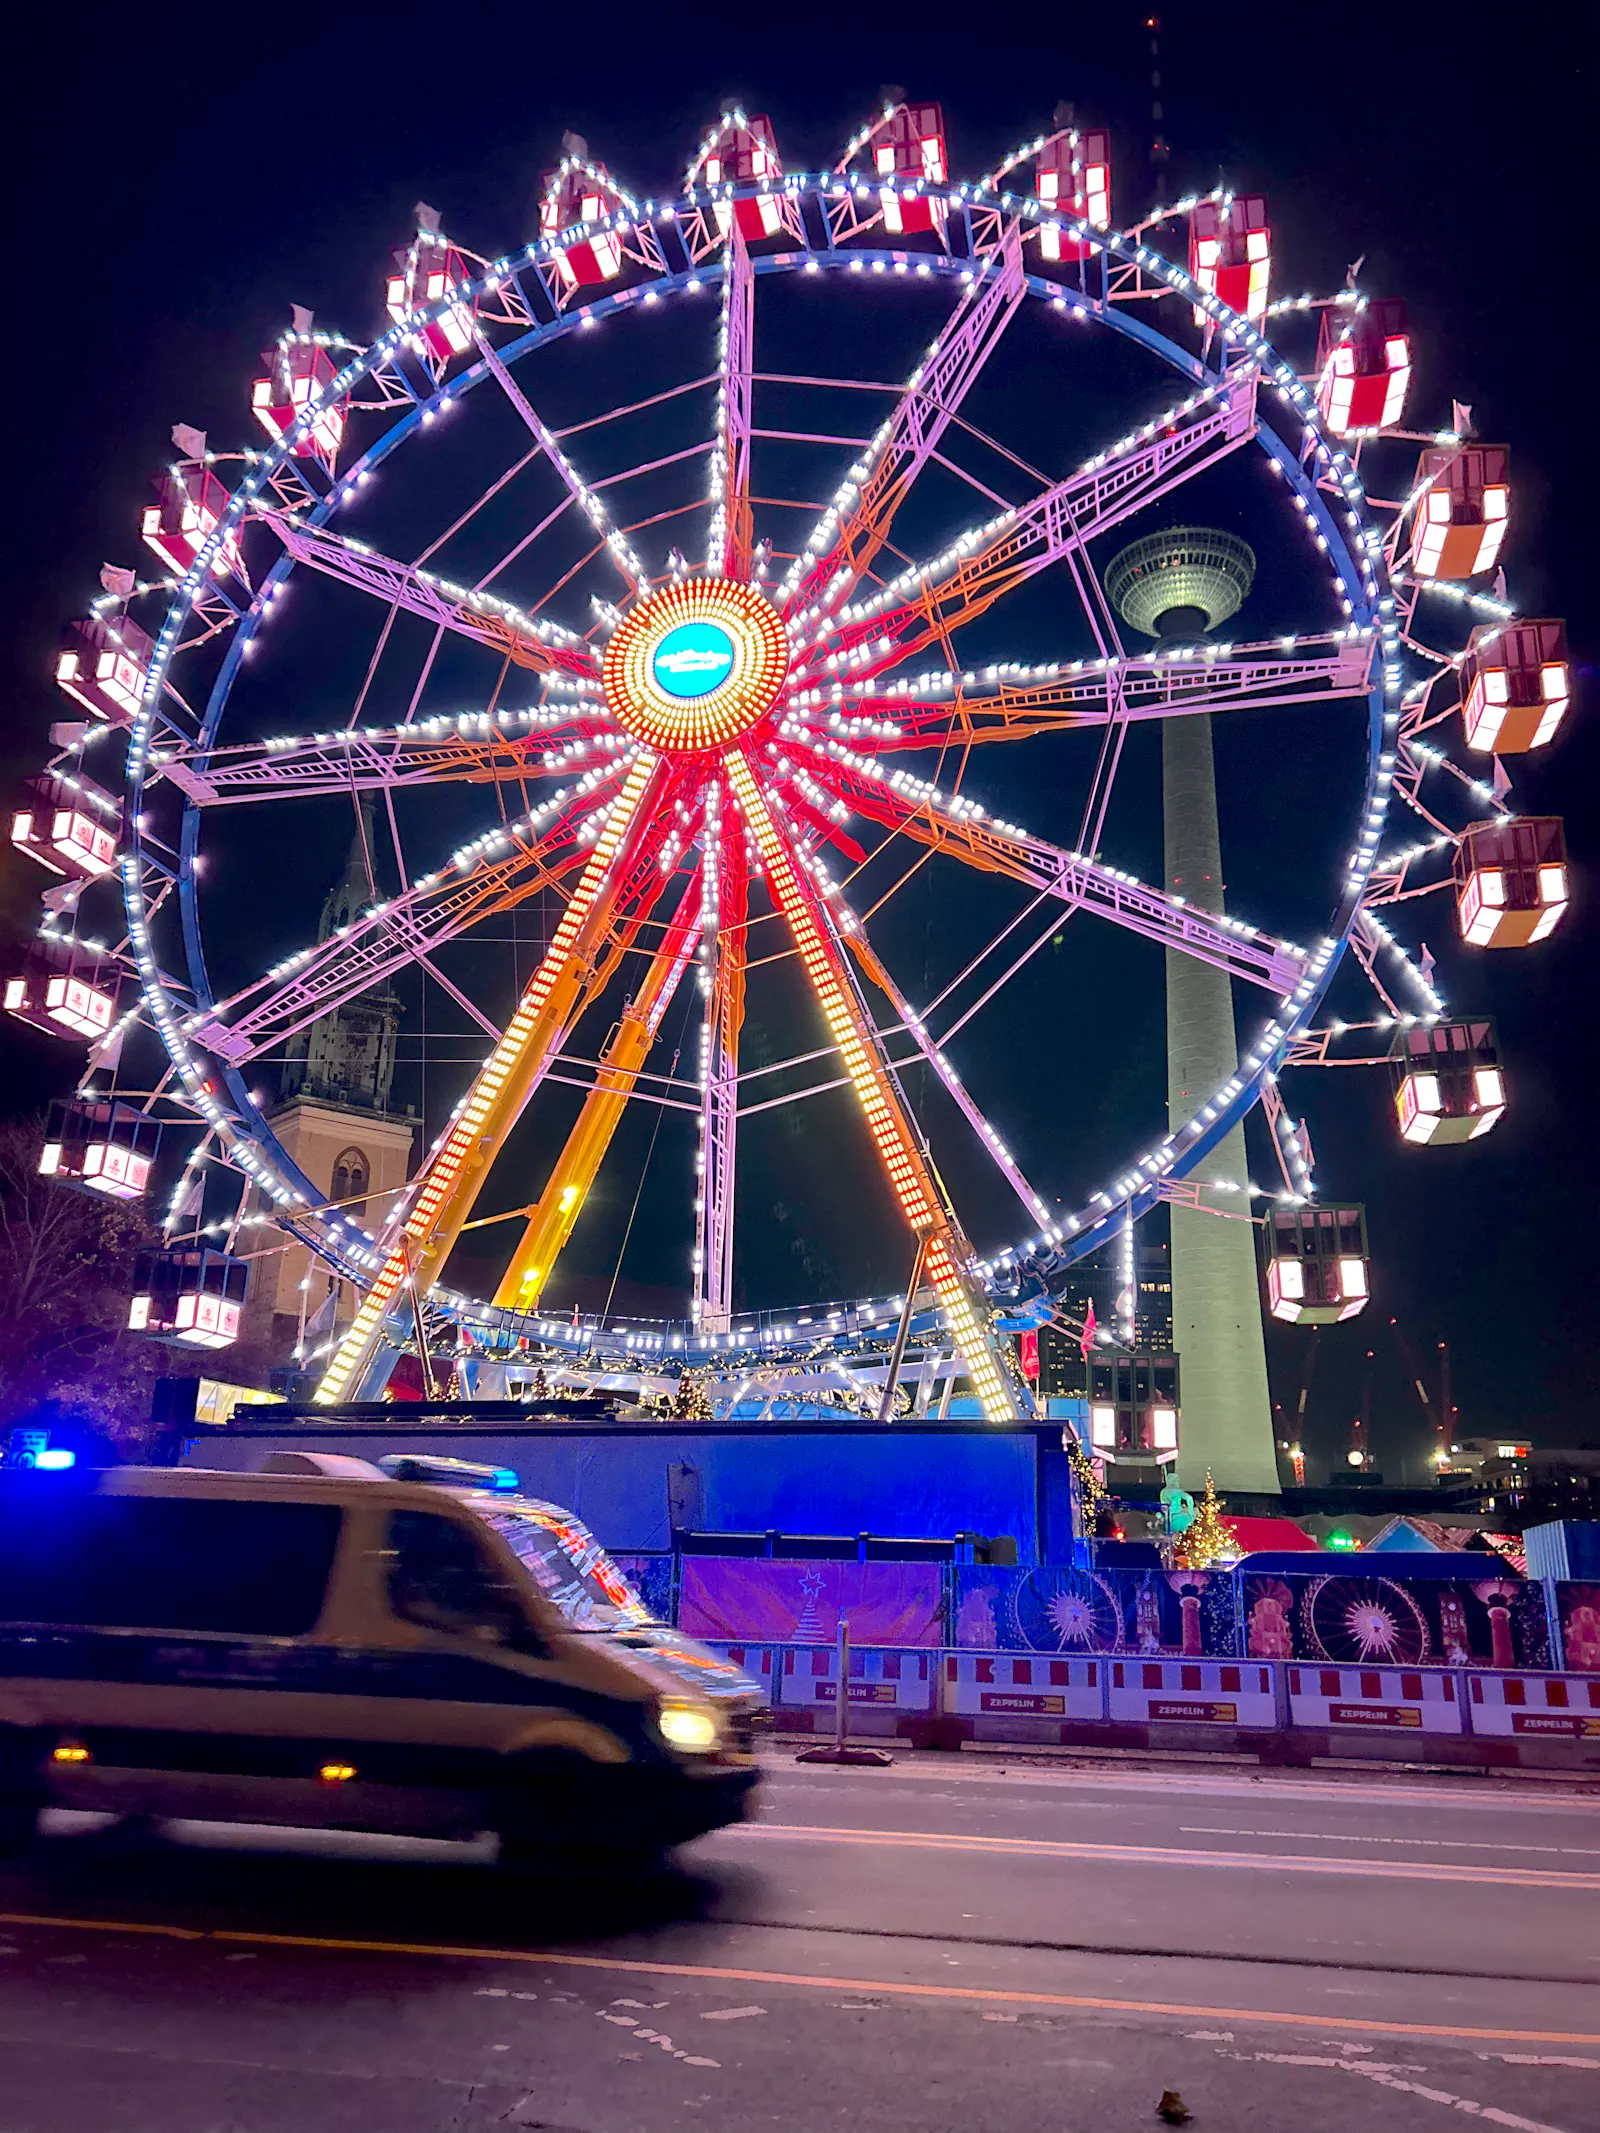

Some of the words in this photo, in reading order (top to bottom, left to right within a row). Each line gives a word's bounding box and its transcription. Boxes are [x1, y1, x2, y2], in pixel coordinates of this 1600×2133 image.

[824, 1687, 867, 1697] ZEELIN
[990, 1698, 1035, 1708] ZEPPELIN
[1158, 1706, 1205, 1715] ZEPPELIN
[1340, 1709, 1388, 1719] ZEPPELIN
[1523, 1719, 1574, 1729] ZEPPELIN
